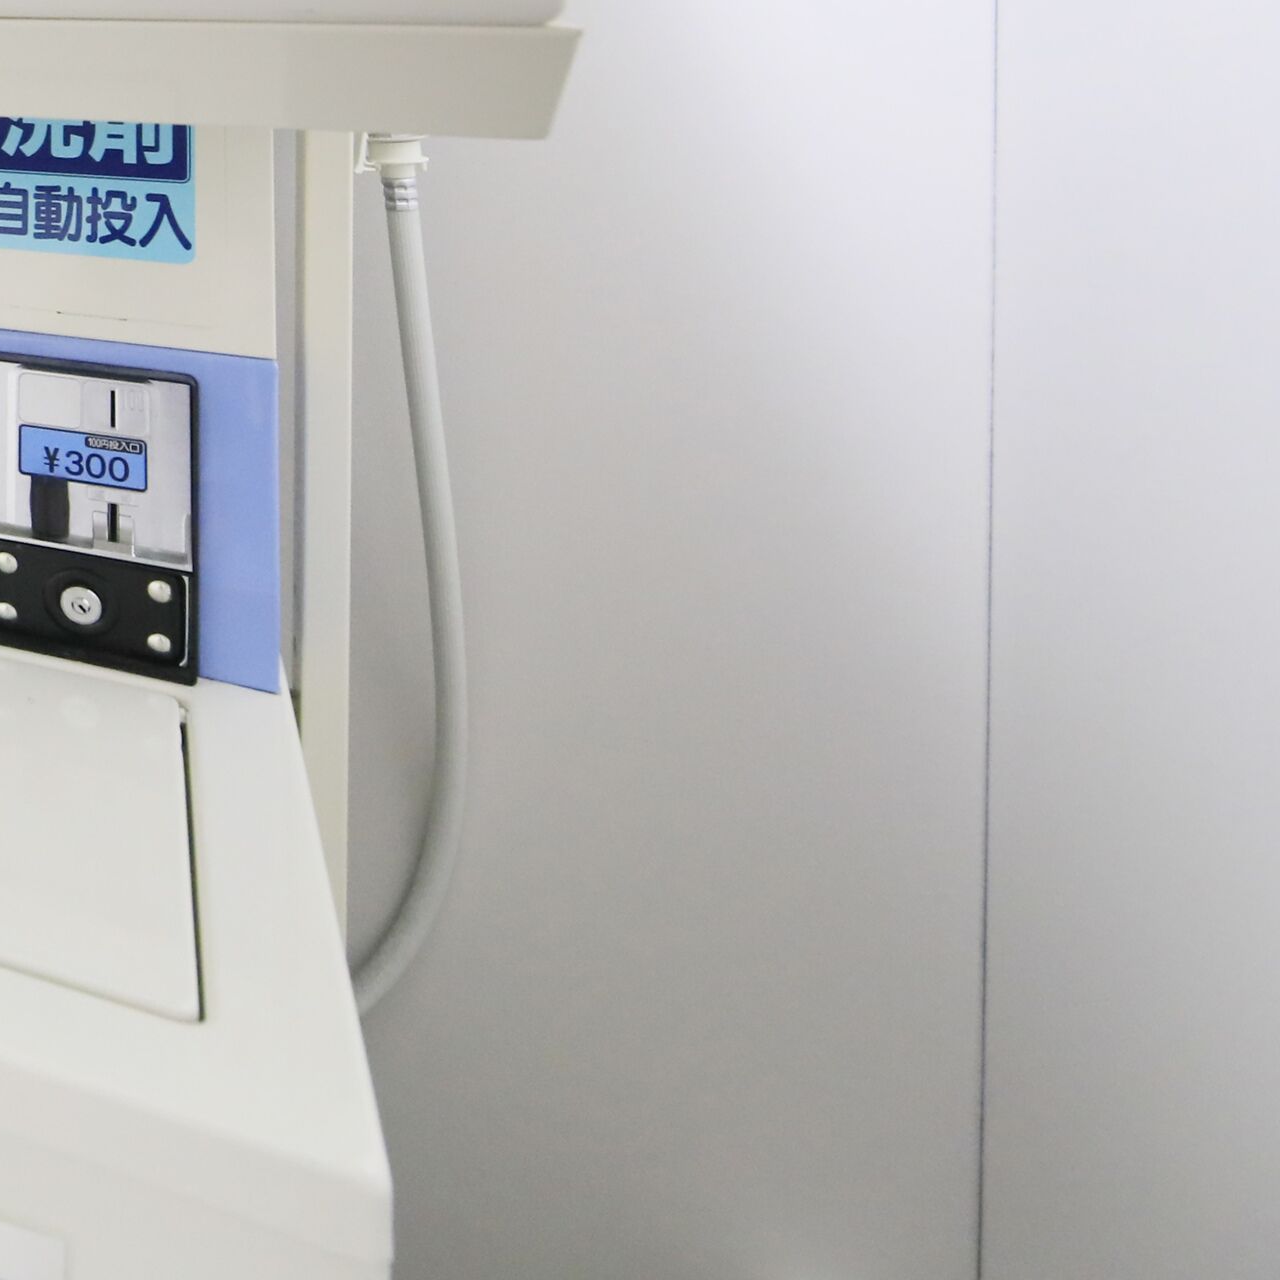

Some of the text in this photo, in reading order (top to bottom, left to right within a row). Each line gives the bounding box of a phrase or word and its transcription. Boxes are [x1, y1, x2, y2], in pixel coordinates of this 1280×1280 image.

[87, 436, 140, 454] 100円投入口
[42, 445, 130, 484] ¥300
